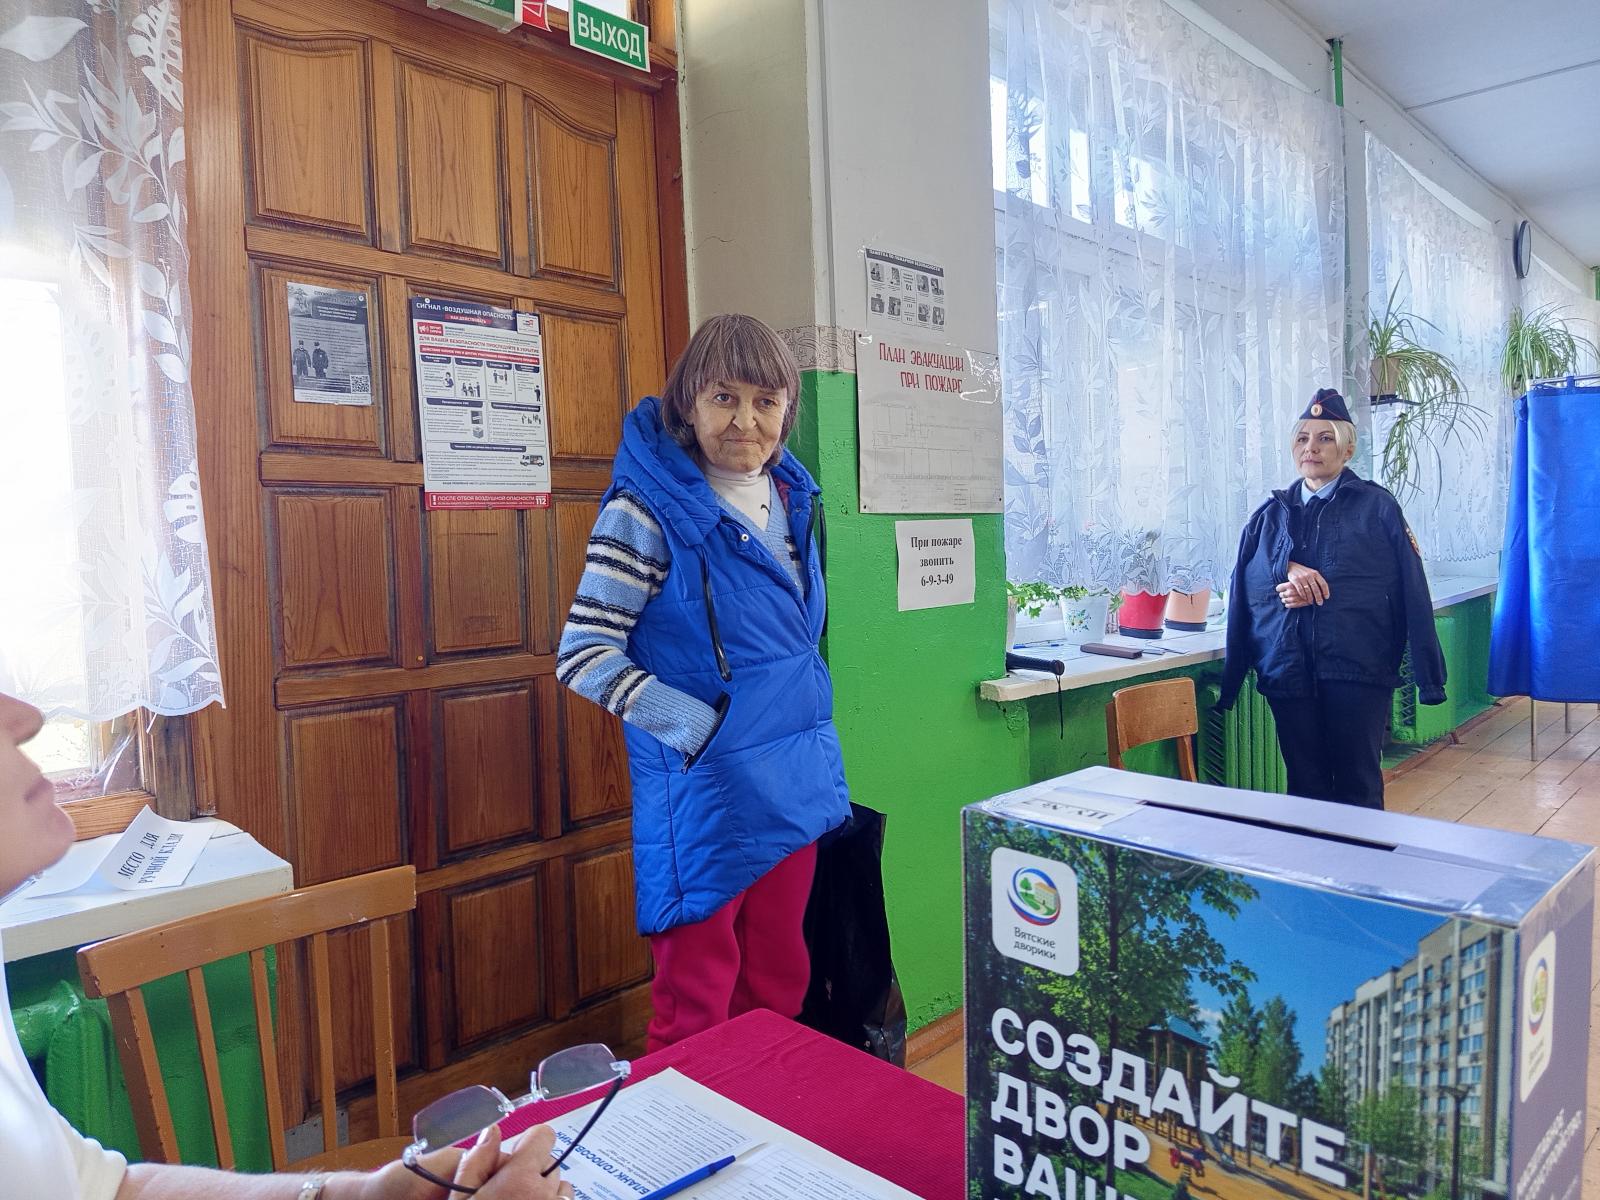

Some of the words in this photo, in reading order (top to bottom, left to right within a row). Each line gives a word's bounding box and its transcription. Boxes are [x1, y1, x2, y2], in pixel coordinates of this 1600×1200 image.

[577, 12, 642, 62] ВЫХОД
[879, 342, 906, 364] ПЛАН
[910, 350, 965, 373] ЭВАКУАЦИИ
[900, 371, 920, 389] ПРИ
[910, 536, 929, 550] При
[931, 537, 963, 548] пожаре
[919, 557, 954, 567] звонить
[920, 573, 954, 587] 6-9-3-49
[117, 851, 146, 879] МЕСТО
[1013, 926, 1056, 949] Вятские
[1013, 941, 1056, 960] дворики
[991, 1007, 1346, 1187] СОЗДАЙТЕ
[991, 1072, 1151, 1171] ДВОР
[616, 1172, 651, 1195] БЛАНК
